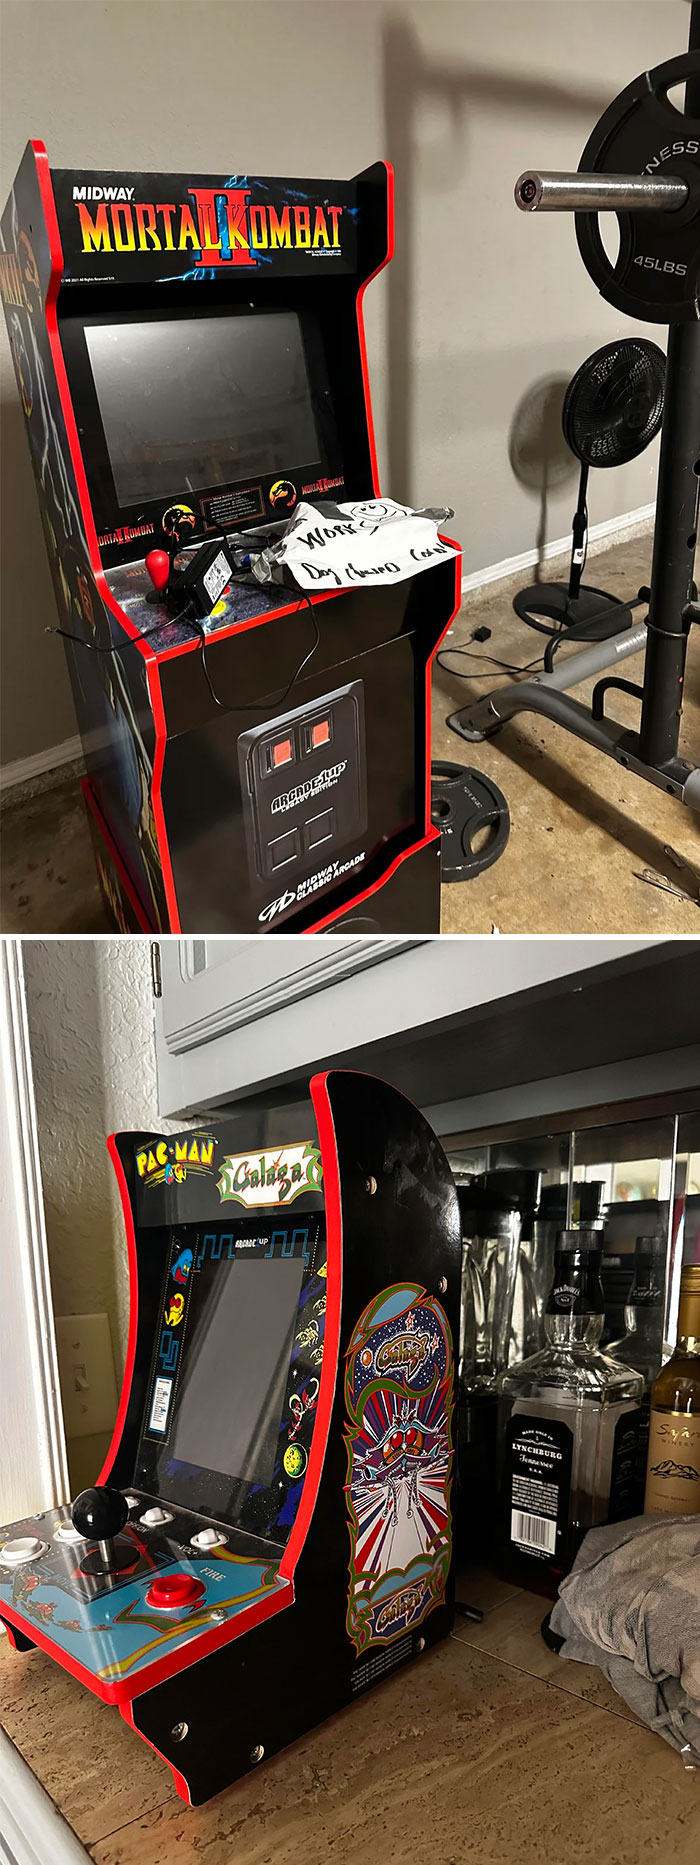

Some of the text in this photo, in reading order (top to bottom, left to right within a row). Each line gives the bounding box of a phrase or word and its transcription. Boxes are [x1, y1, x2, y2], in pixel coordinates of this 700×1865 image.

[641, 140, 699, 176] NESS
[75, 203, 343, 253] MORTAL KOMBAT
[633, 255, 688, 276] 45LBS
[98, 531, 123, 547] ORTAL
[301, 562, 342, 586] Dog
[296, 852, 366, 901] CLASSIC ARCADE
[297, 860, 339, 893] MIDWAY
[136, 1139, 214, 1177] PAC-MAN
[232, 1156, 306, 1202] Galaga
[378, 1335, 428, 1377] Galaga
[512, 1443, 562, 1459] LYNCHBURG
[200, 1567, 226, 1582] FIRE
[376, 1584, 424, 1632] Galaga
